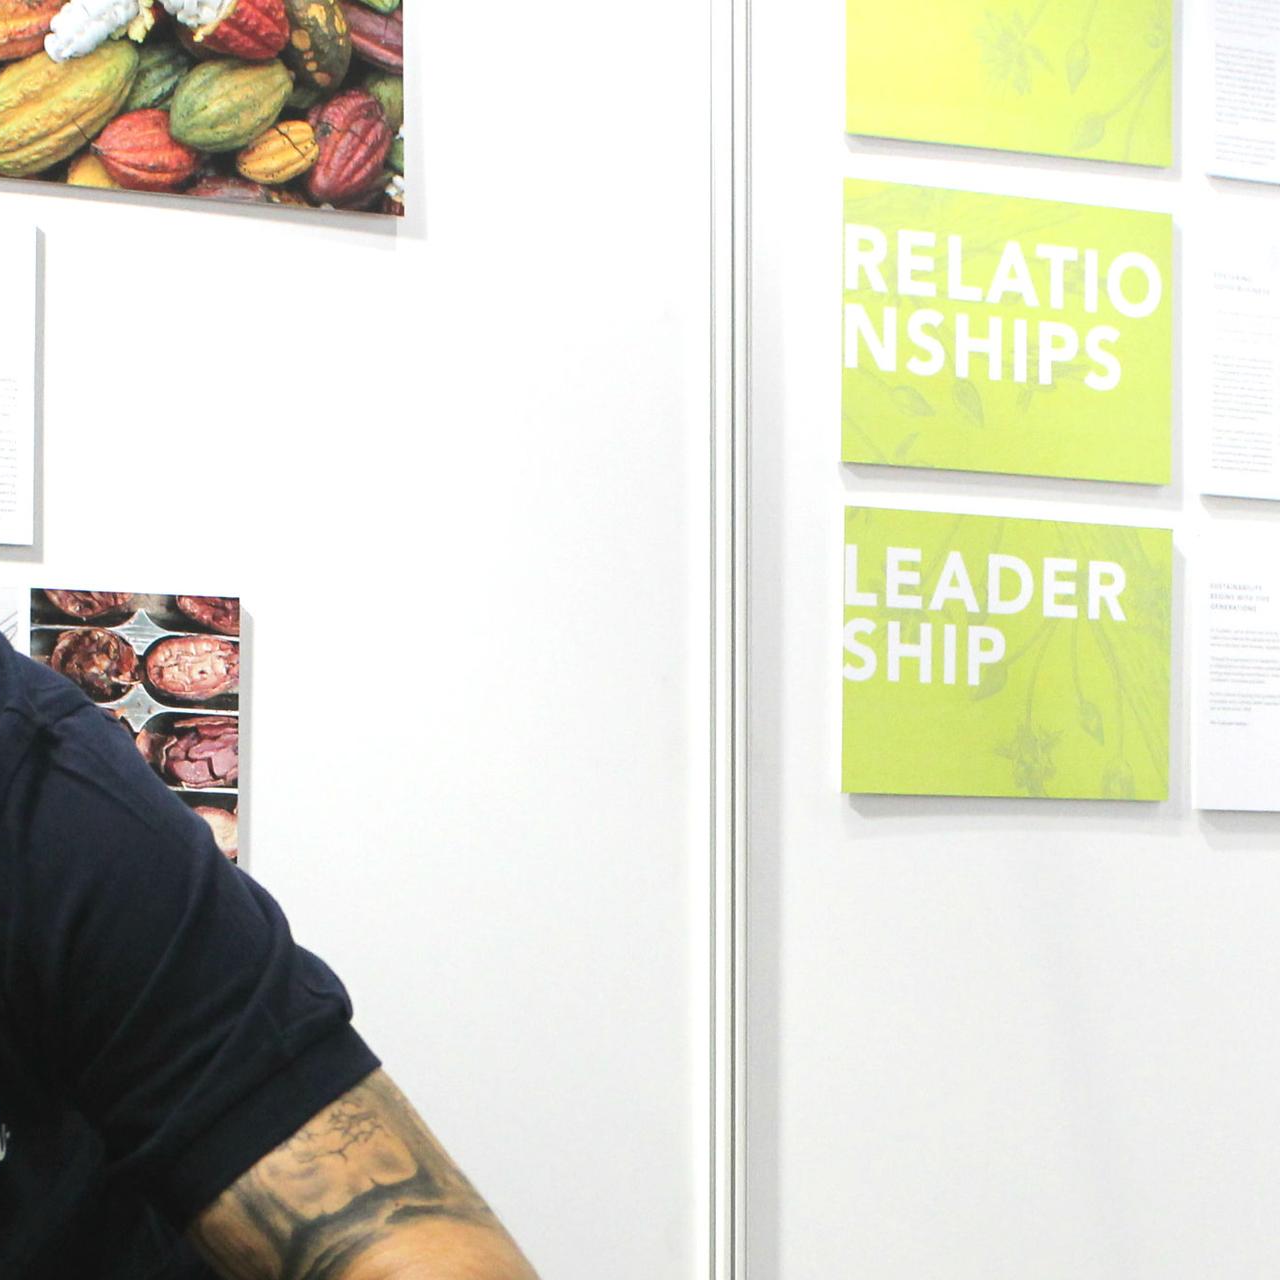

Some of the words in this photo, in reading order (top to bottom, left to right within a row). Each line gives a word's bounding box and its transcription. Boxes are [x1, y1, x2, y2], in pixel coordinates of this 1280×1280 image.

[844, 223, 1163, 319] RELATIO
[844, 303, 1122, 392] NSHIPS
[844, 544, 1127, 621] LEADER
[843, 618, 1006, 686] SHIP
